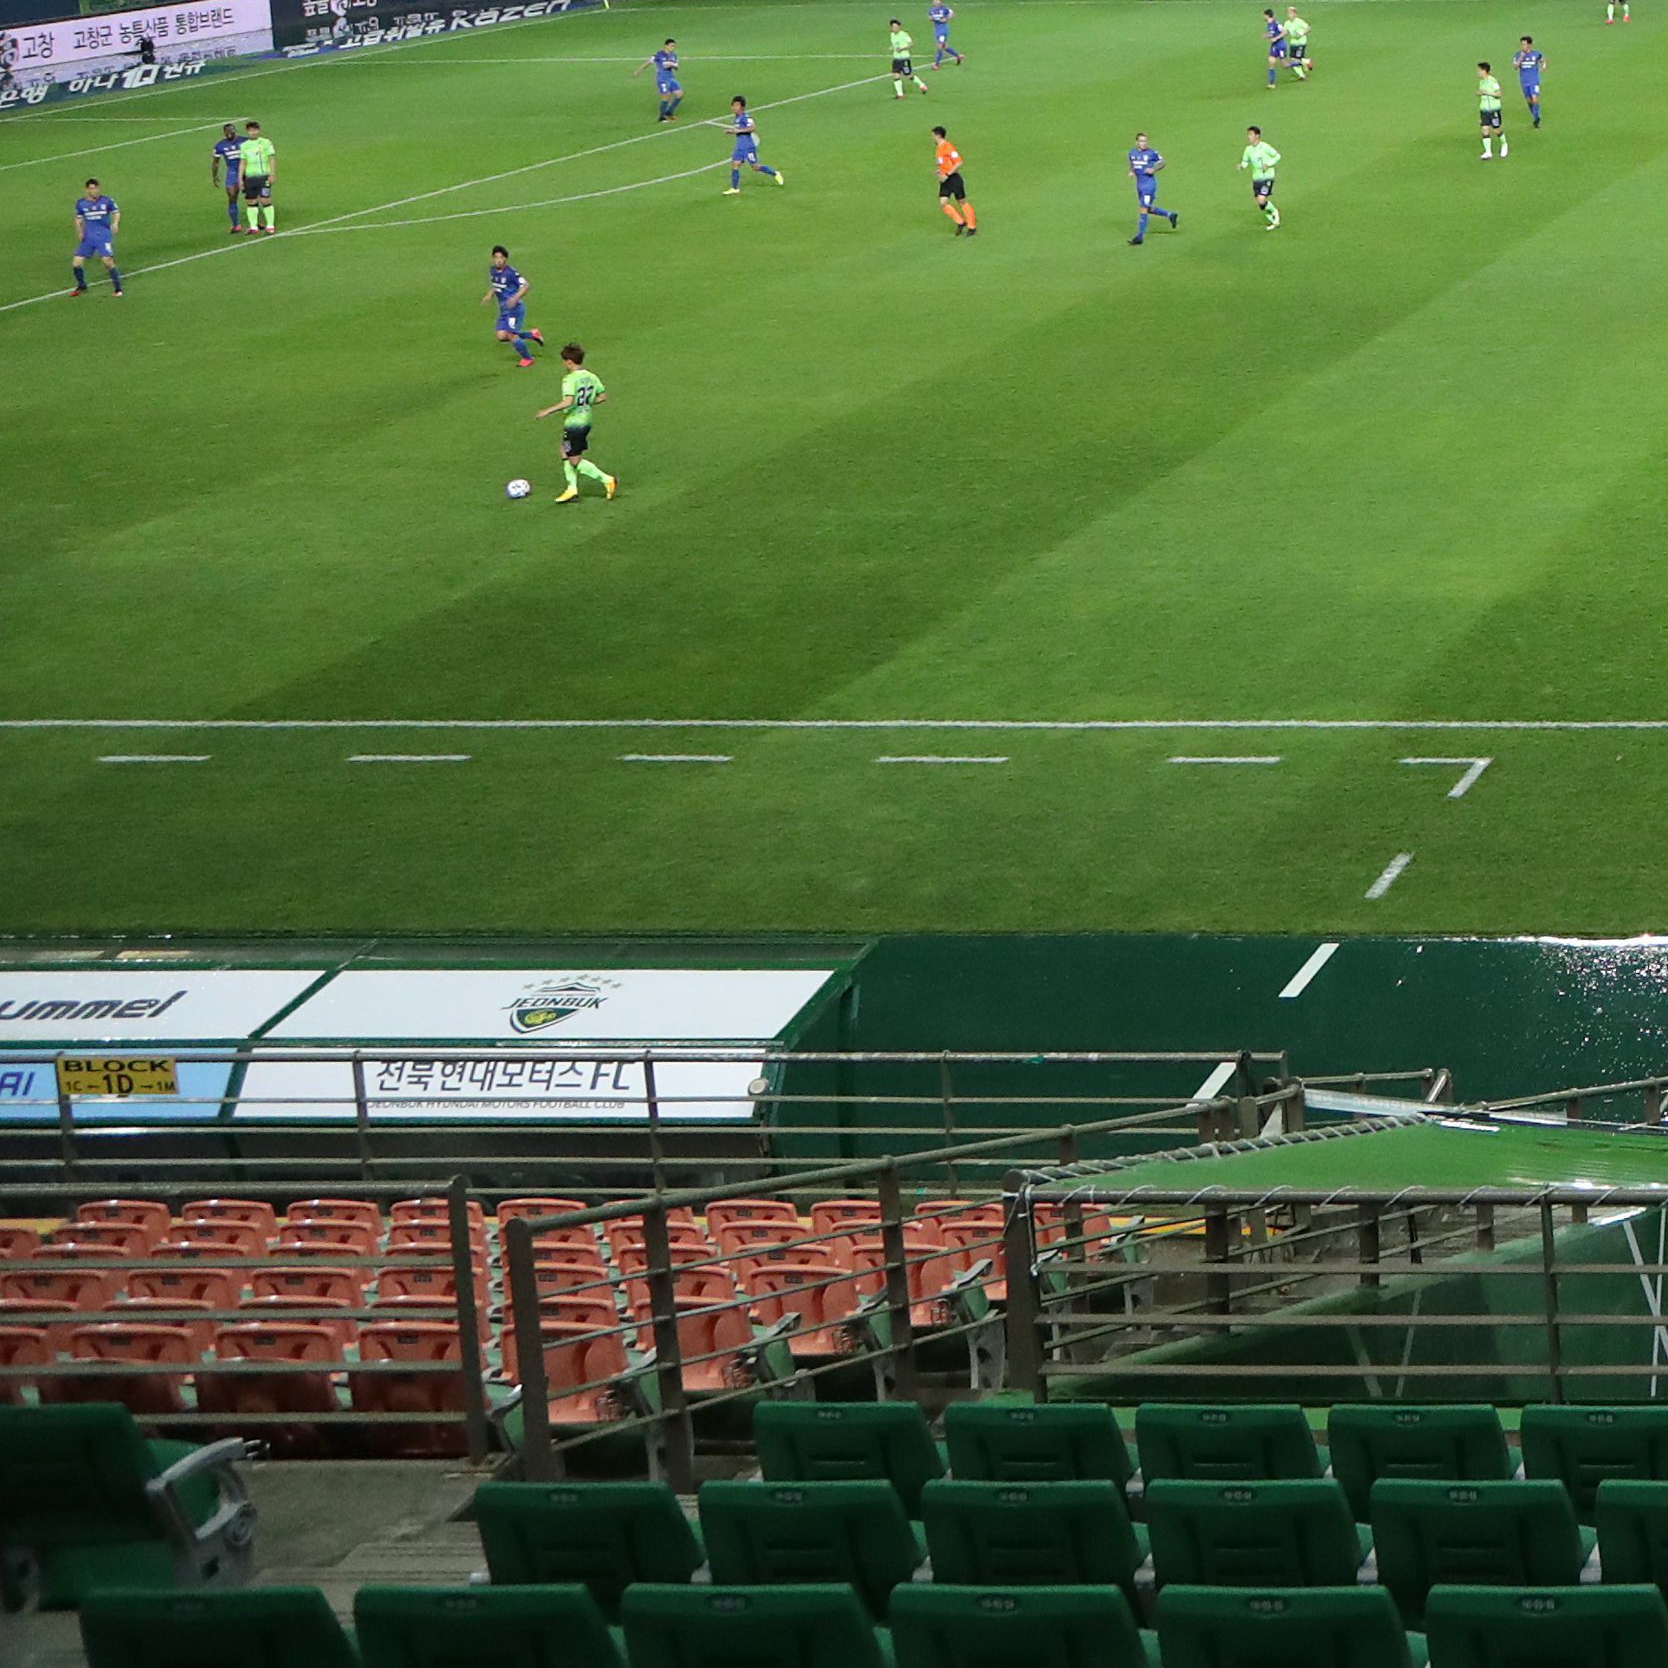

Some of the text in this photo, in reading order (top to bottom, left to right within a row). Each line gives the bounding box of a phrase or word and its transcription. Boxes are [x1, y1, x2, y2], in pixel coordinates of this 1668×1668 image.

[73, 26, 113, 49] 고창군
[501, 997, 608, 1010] JEONBUK
[64, 1060, 169, 1072] BLOCK
[67, 1082, 82, 1092] 1C
[102, 1075, 134, 1095] 1D
